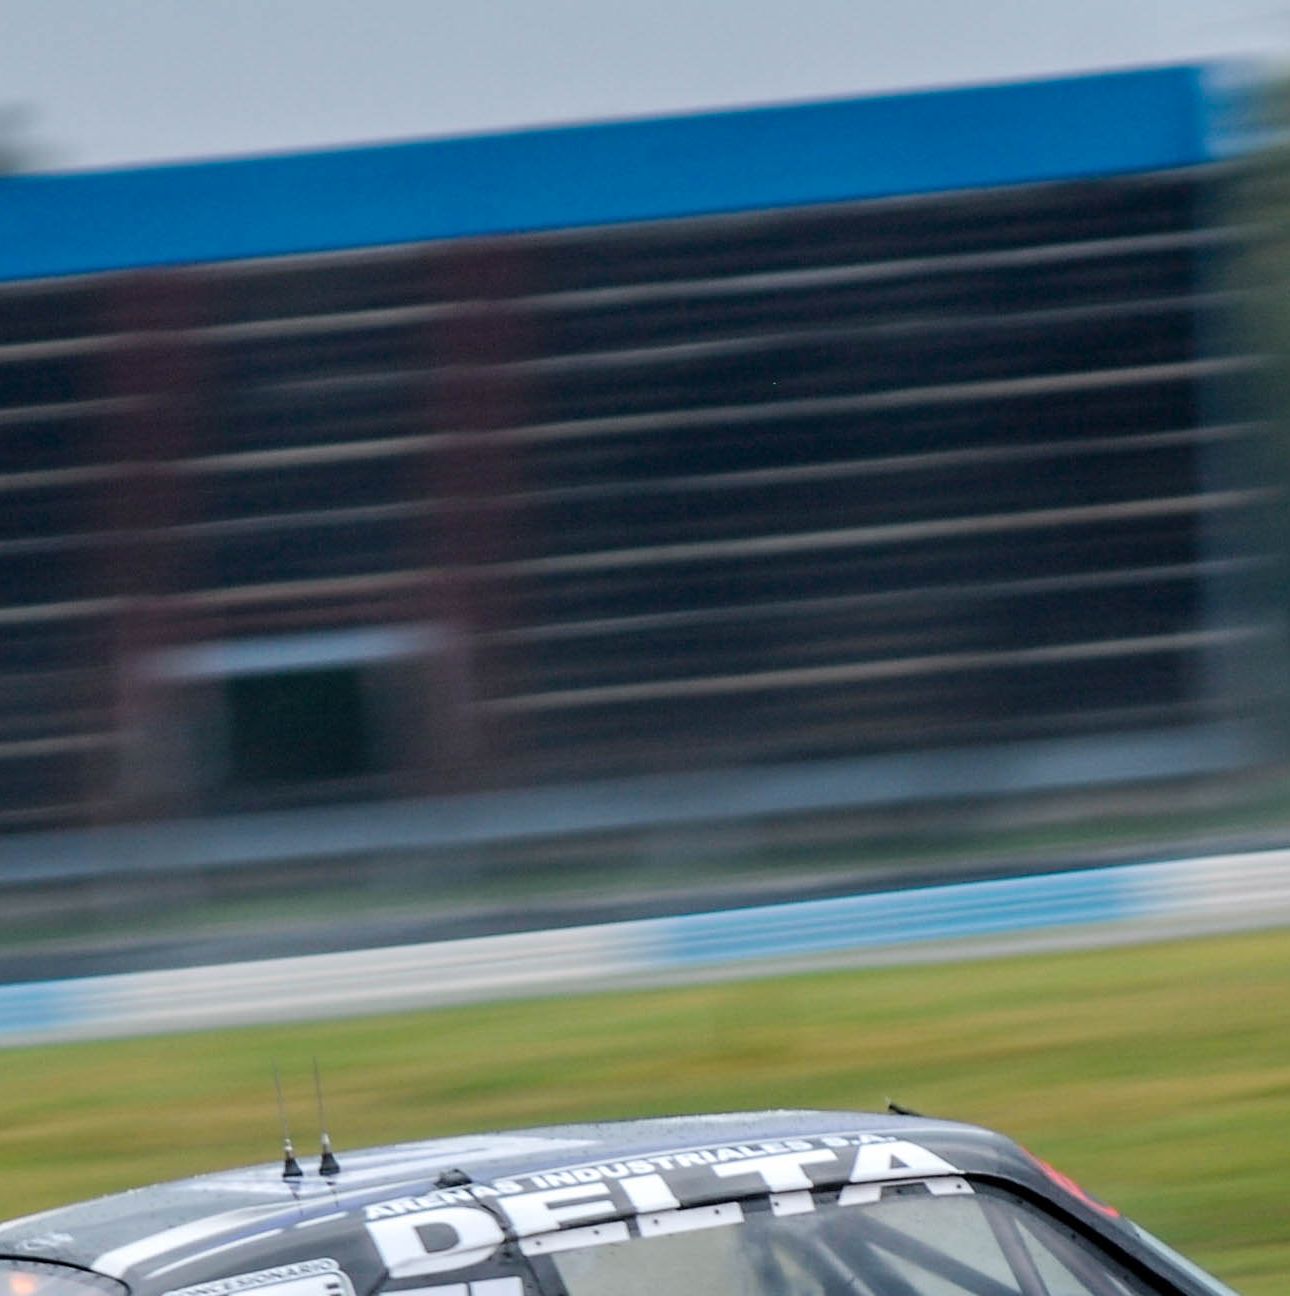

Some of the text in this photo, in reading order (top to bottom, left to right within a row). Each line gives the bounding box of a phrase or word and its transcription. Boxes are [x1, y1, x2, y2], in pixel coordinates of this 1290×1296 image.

[365, 1177, 525, 1222] ARENAS
[530, 1138, 814, 1201] INDUSTRIALES
[365, 1139, 975, 1279] DELTA
